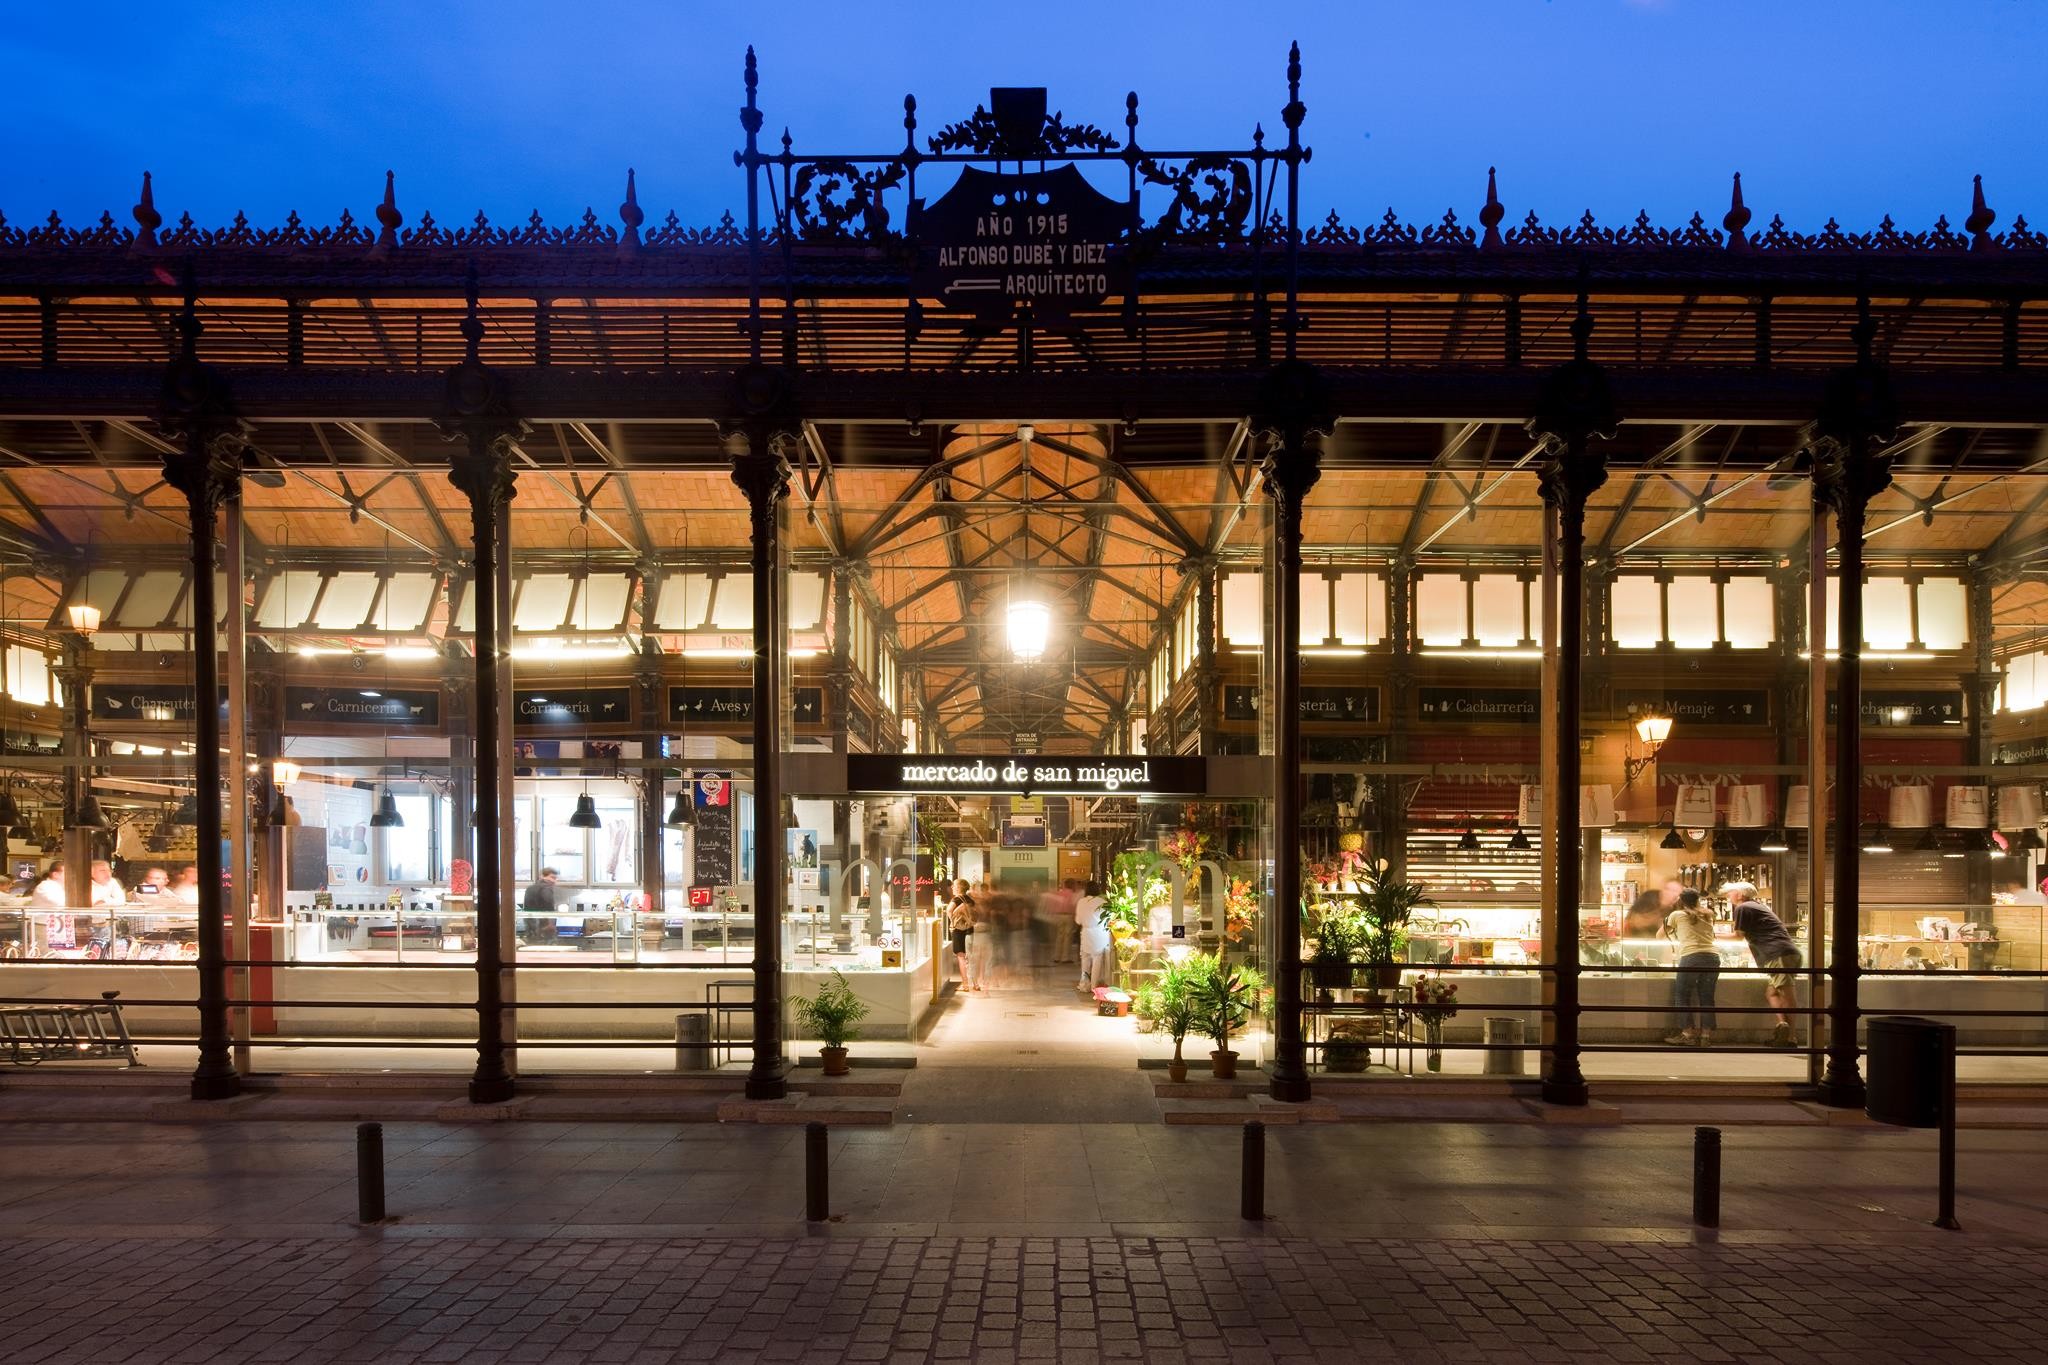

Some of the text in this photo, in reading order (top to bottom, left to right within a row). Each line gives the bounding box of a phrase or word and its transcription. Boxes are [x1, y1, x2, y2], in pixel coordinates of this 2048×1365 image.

[976, 211, 1068, 236] AÑO 1915
[938, 244, 1008, 267] ALFONSO
[1013, 239, 1053, 265] DUBÉ
[1058, 244, 1067, 265] Y
[130, 694, 196, 711] Charcuter
[519, 699, 590, 715] Carnicería
[710, 698, 751, 717] Aves y
[1299, 698, 1337, 712] stería
[1456, 698, 1536, 713] Cacharrería
[1665, 700, 1715, 718] Menaje
[1861, 700, 1922, 716] charrería
[4, 736, 53, 756] Salazones
[902, 760, 1150, 790] mercado de san miguel
[902, 875, 934, 885] Bocherie
[692, 891, 710, 904] 27
